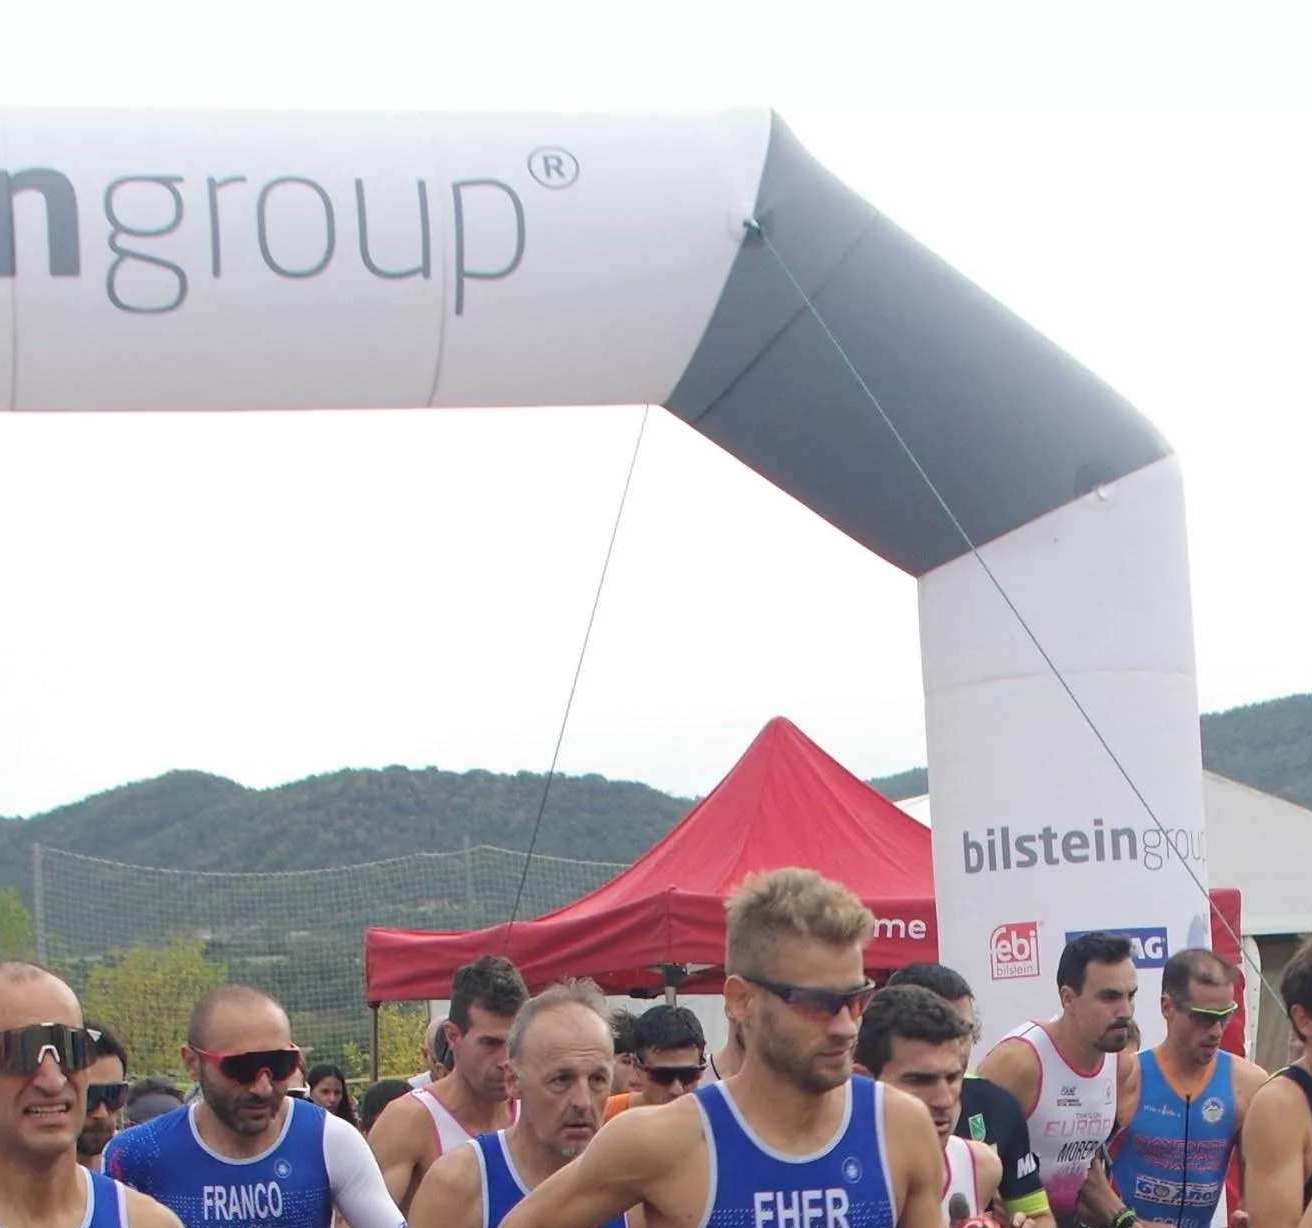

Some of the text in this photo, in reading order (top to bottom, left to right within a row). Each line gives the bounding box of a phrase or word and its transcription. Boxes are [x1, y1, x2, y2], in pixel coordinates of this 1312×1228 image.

[963, 819, 1205, 873] bilsteingrou
[990, 926, 1038, 968] febi
[1135, 936, 1163, 960] AG
[996, 963, 1033, 976] bilstein
[203, 1181, 283, 1220] FRANCO
